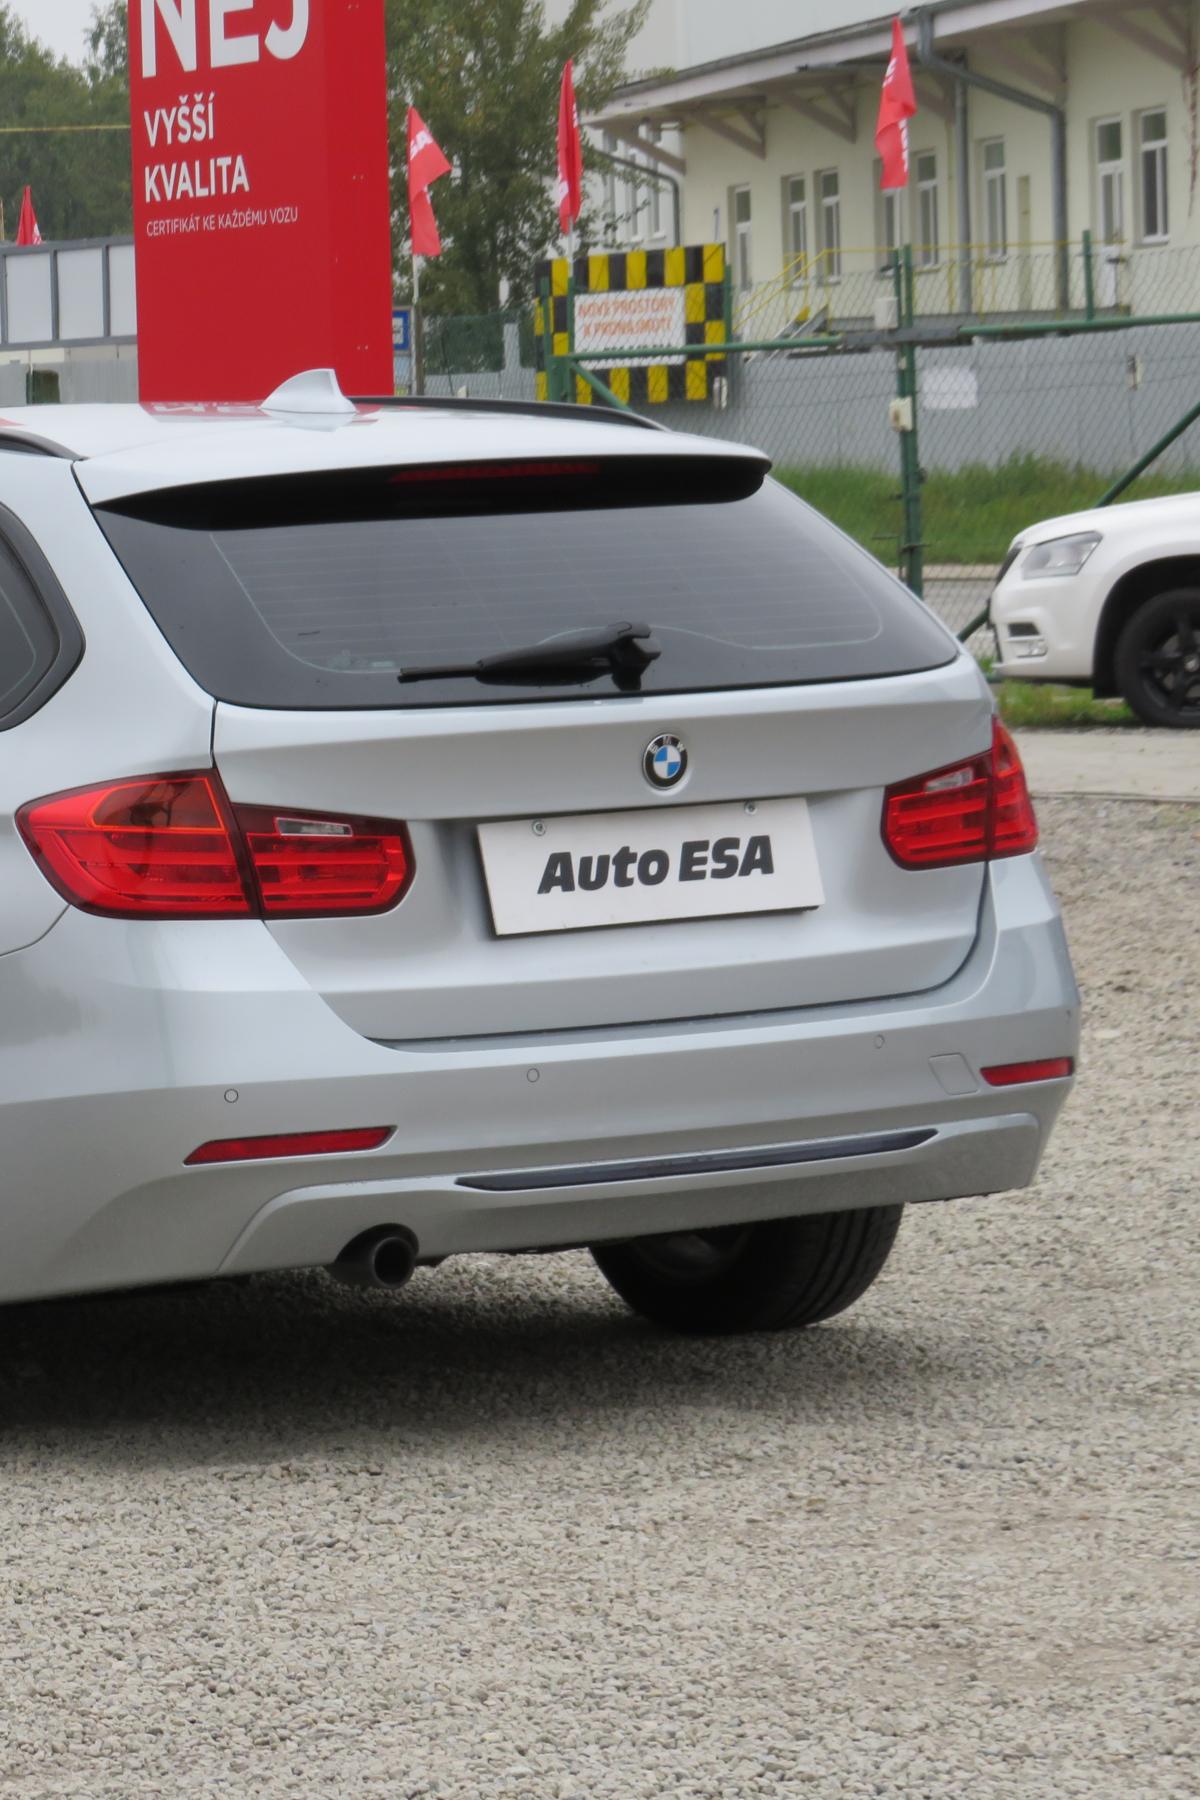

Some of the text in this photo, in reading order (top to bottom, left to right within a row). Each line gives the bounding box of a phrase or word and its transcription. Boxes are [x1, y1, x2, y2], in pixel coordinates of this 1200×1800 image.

[144, 91, 215, 148] VYŠŠÍ
[144, 155, 250, 203] KVALITA
[146, 206, 298, 237] CERTIFIKÁT KE KAŽDÉMU VOZU
[537, 835, 774, 895] Auto ESA
